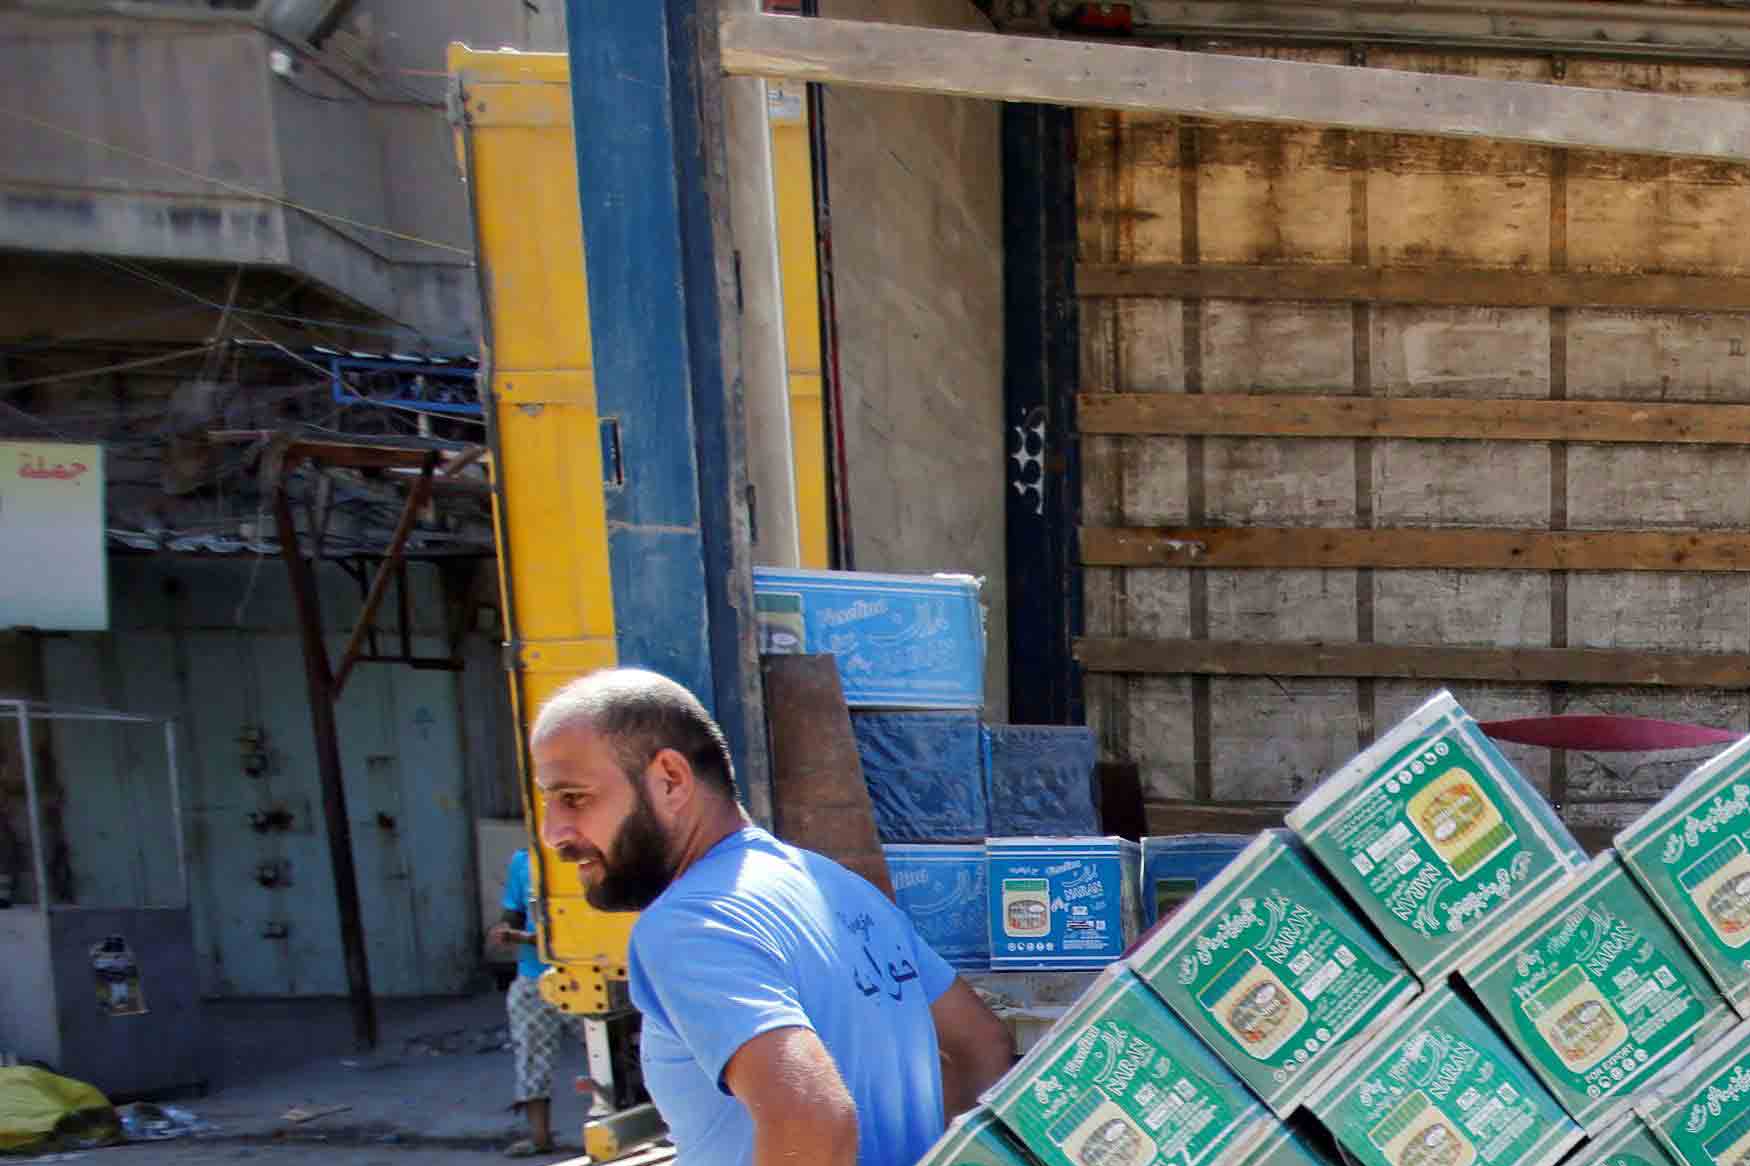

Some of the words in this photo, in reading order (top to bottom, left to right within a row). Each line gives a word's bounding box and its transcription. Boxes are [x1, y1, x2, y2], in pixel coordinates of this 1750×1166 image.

[1391, 861, 1441, 920] NARAN
[1265, 903, 1312, 963] NARAN
[1586, 918, 1636, 977] NARAN
[1105, 1036, 1150, 1095] NARAN
[1429, 1040, 1475, 1099] NARAN
[1584, 1066, 1603, 1084] FOR
[1600, 1043, 1634, 1070] EXPORT
